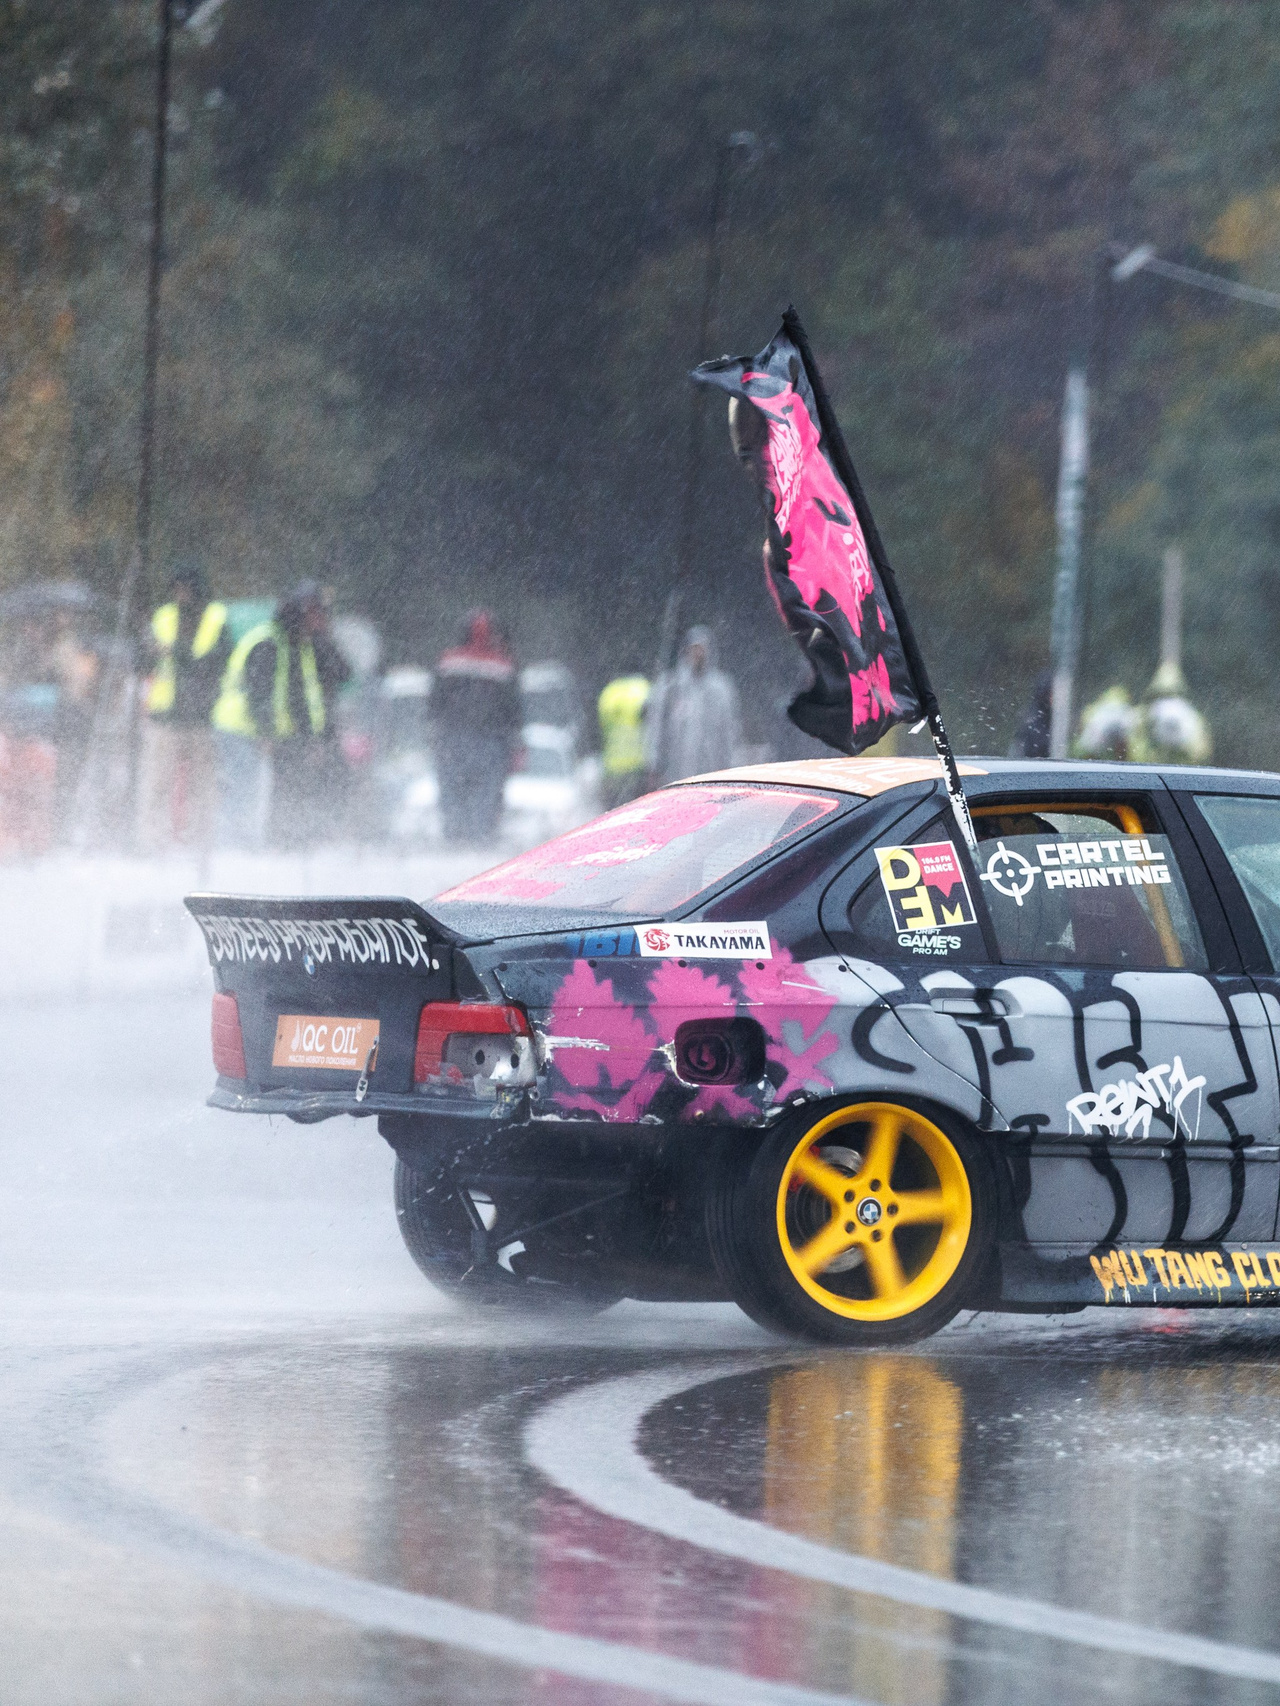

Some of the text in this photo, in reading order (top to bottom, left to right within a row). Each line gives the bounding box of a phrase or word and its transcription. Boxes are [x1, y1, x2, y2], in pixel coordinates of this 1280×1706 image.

[1036, 839, 1165, 866] CARTEL
[923, 862, 954, 874] DANCE
[1043, 865, 1172, 889] PRINTING
[674, 934, 766, 950] TAKAYAMA
[898, 934, 961, 949] GAME'S
[303, 1024, 358, 1054] QC OIL
[1089, 1250, 1148, 1289] WU
[1144, 1248, 1231, 1288] TANG
